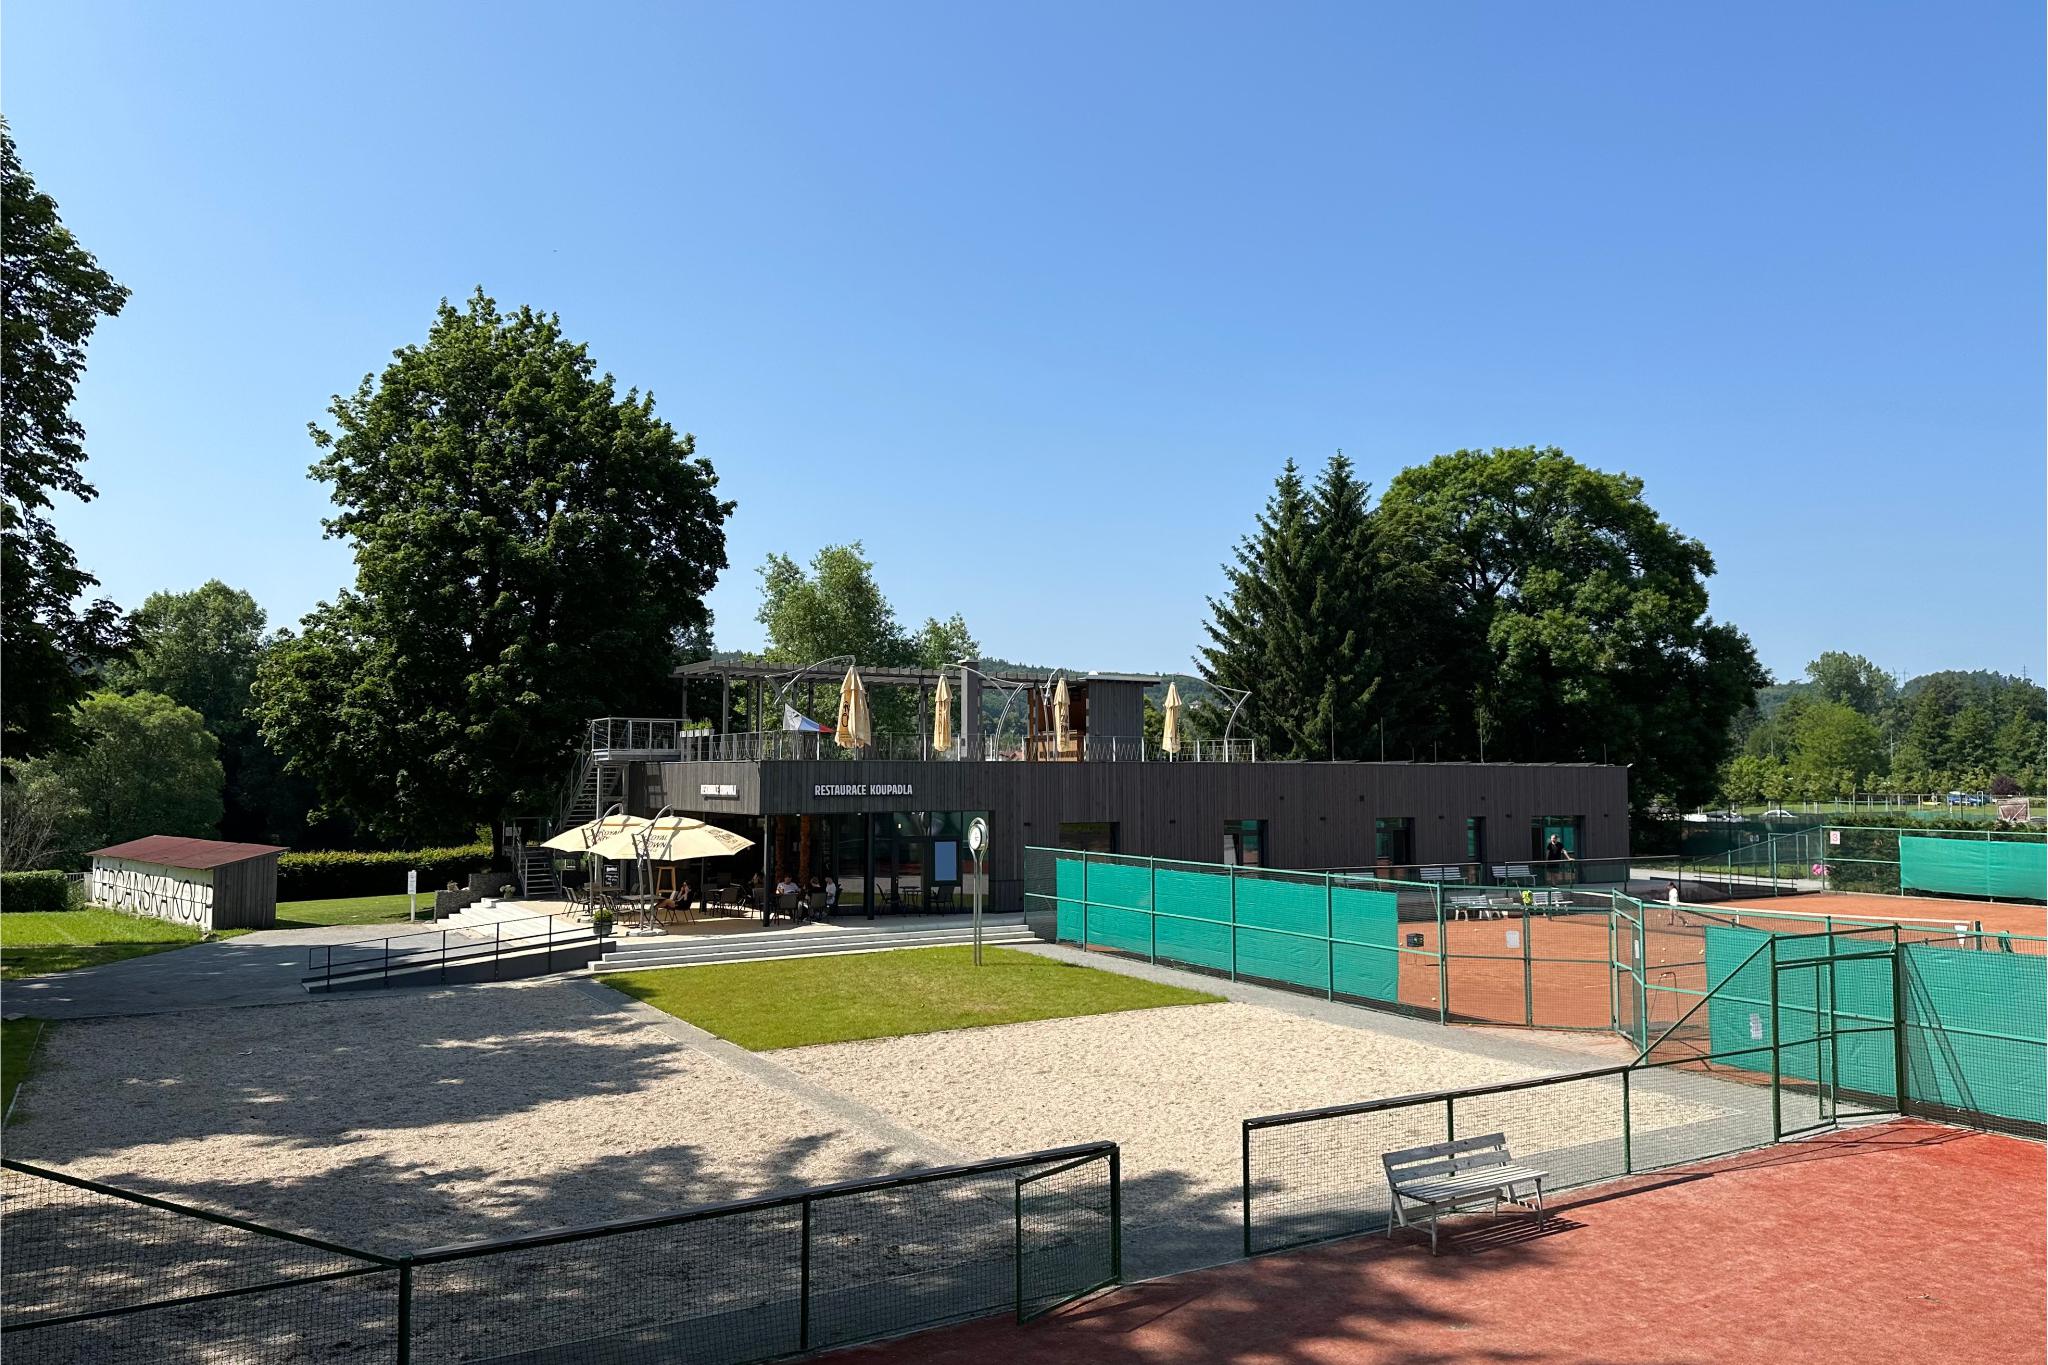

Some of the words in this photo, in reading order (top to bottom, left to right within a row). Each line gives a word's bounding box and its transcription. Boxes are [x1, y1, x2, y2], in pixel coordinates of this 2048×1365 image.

[814, 784, 867, 796] RESTAURACE
[870, 784, 913, 795] KOUPADLA
[1832, 833, 1838, 842] 3
[93, 858, 169, 917] ČERČANSKÁ
[171, 879, 213, 923] KOUP
